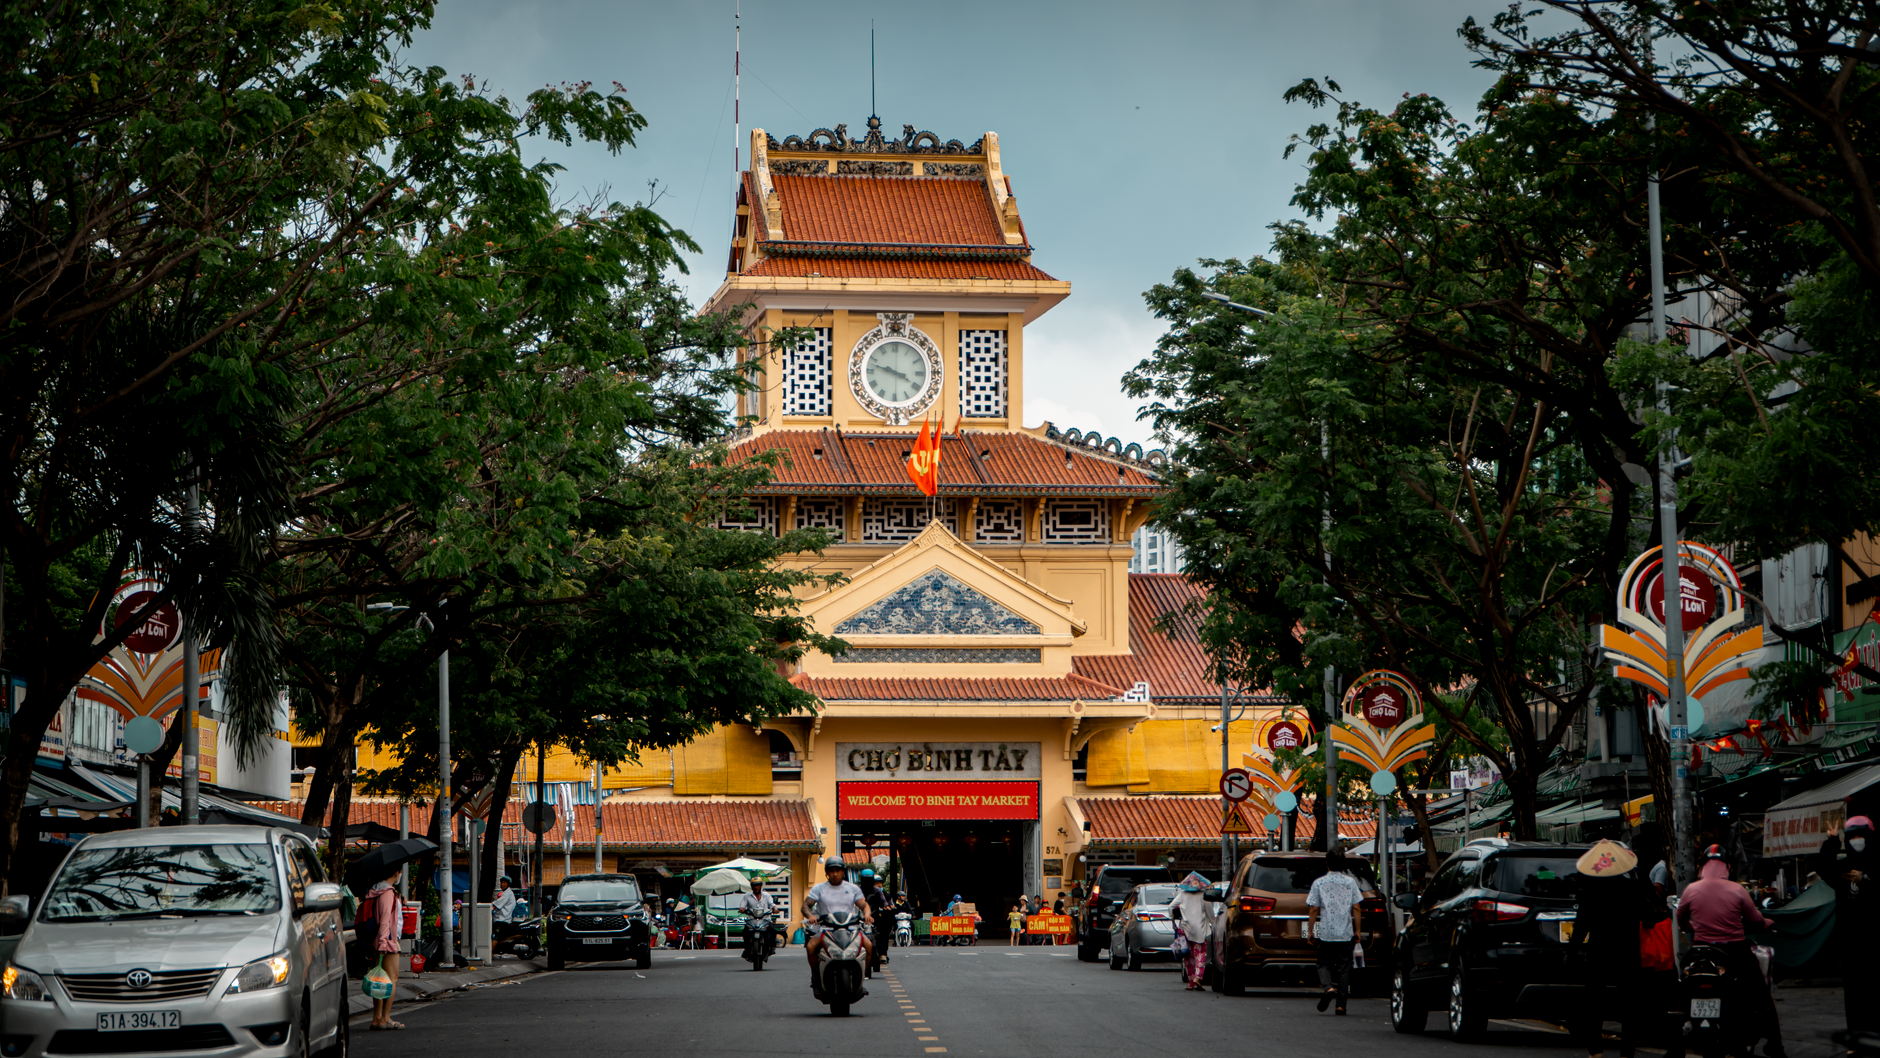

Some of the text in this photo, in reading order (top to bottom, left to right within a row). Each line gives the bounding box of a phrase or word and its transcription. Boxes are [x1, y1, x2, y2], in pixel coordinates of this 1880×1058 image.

[848, 743, 1029, 777] CHỢ BÌNH TÂY
[847, 796, 1030, 806] WELCOME TO BINH TAY MARKET
[1046, 846, 1061, 854] 57A
[932, 918, 949, 931] CẤM
[1028, 917, 1045, 931] CẤM
[100, 1012, 177, 1029] 51A-394.12
